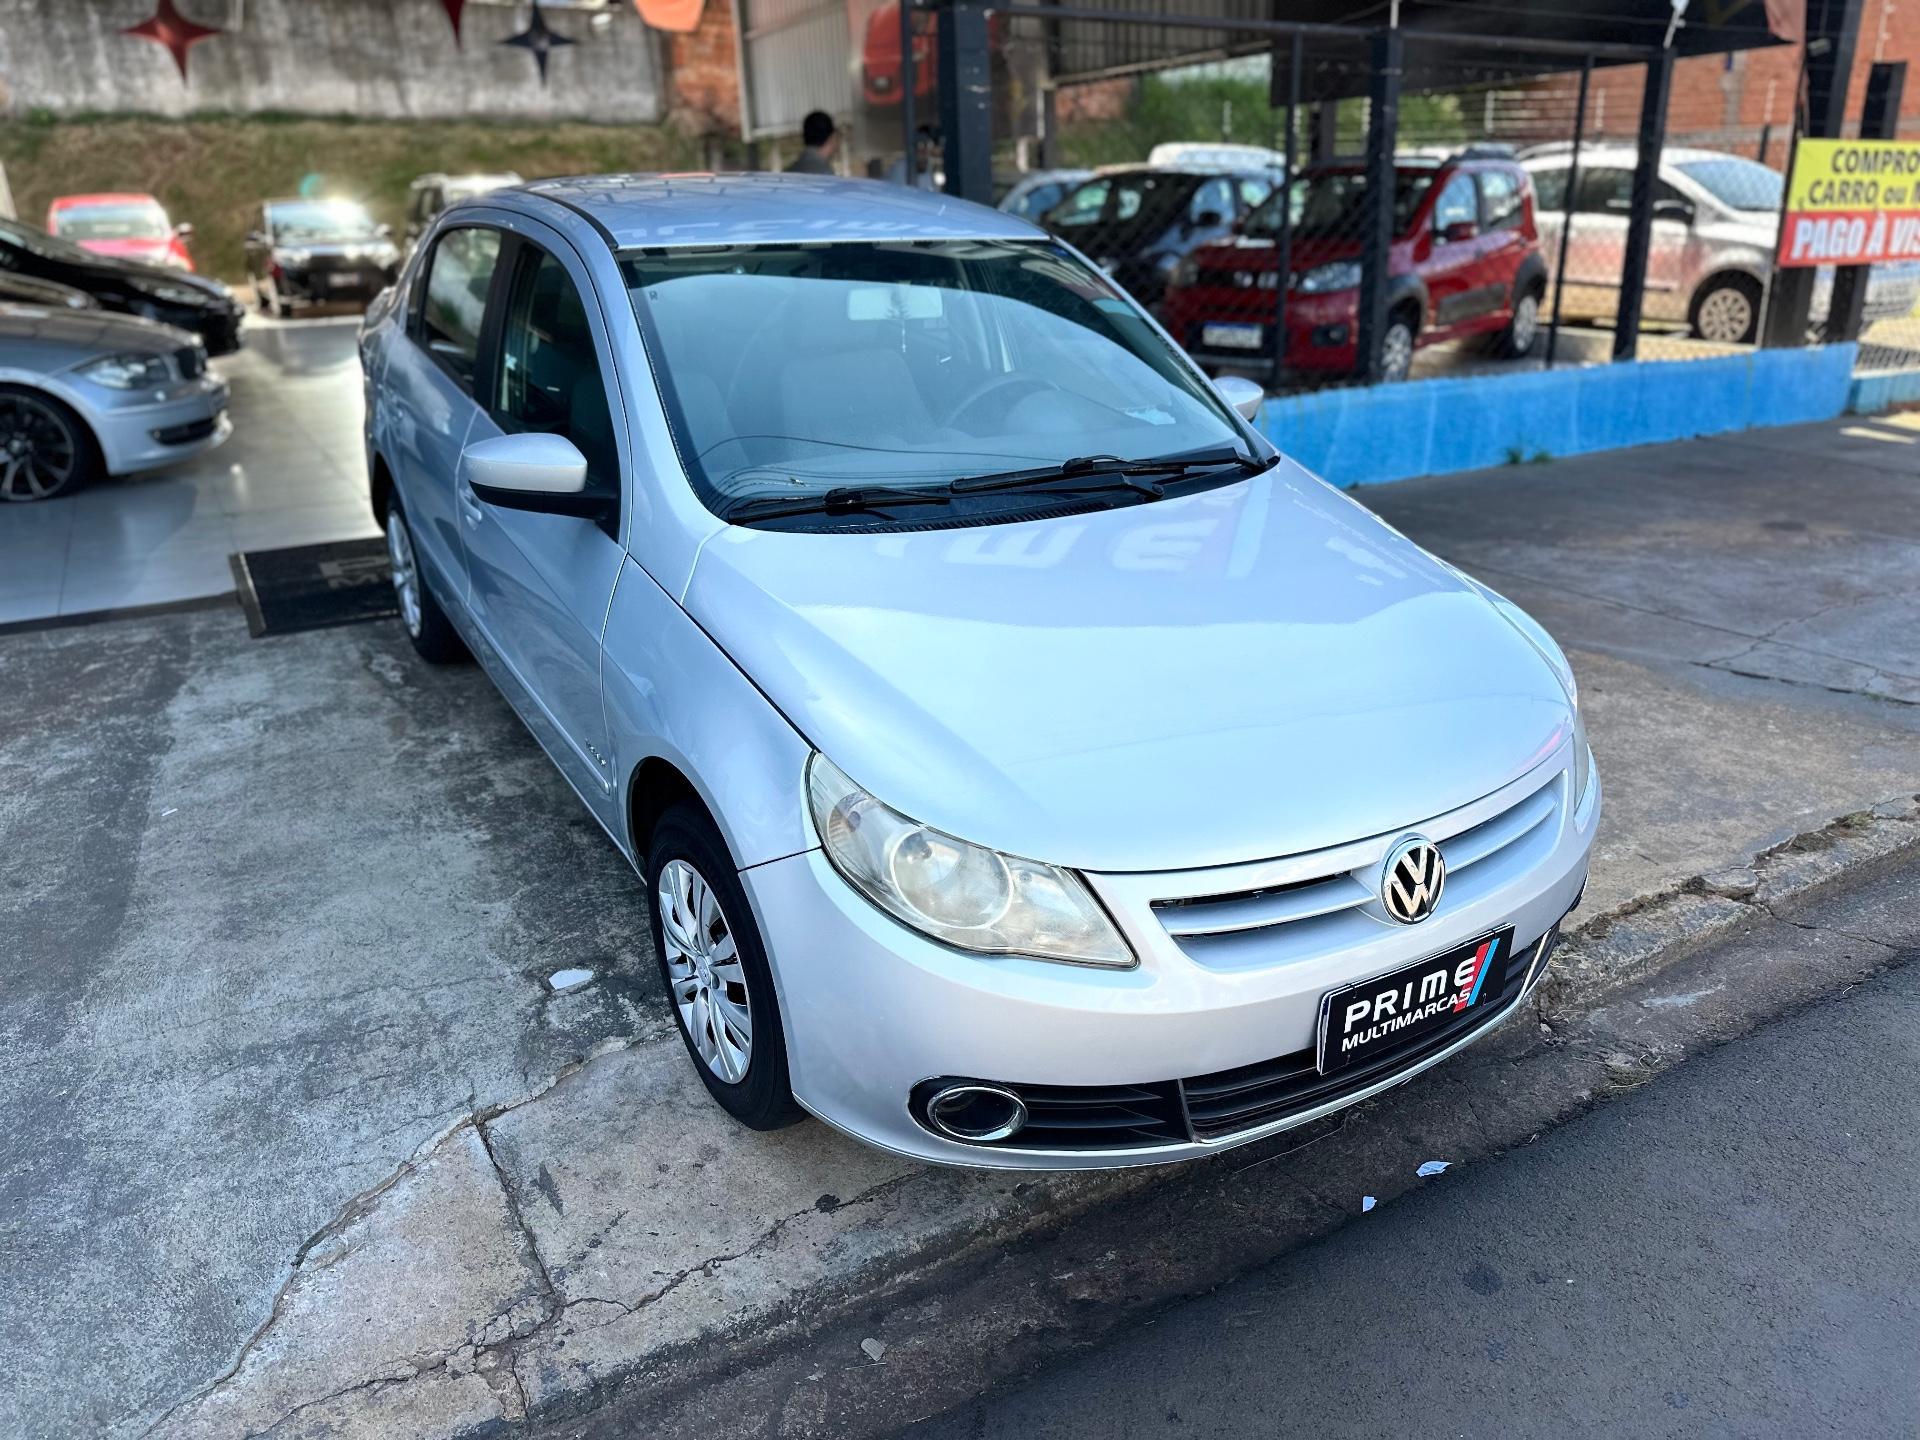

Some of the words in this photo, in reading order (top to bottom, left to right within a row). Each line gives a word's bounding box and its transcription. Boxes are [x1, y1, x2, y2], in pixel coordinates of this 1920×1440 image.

[1832, 149, 1920, 173] COMPRO
[1808, 181, 1879, 204] CARRO
[1792, 218, 1865, 259] PAGO
[1341, 988, 1471, 1052] MULTIMARCAS
